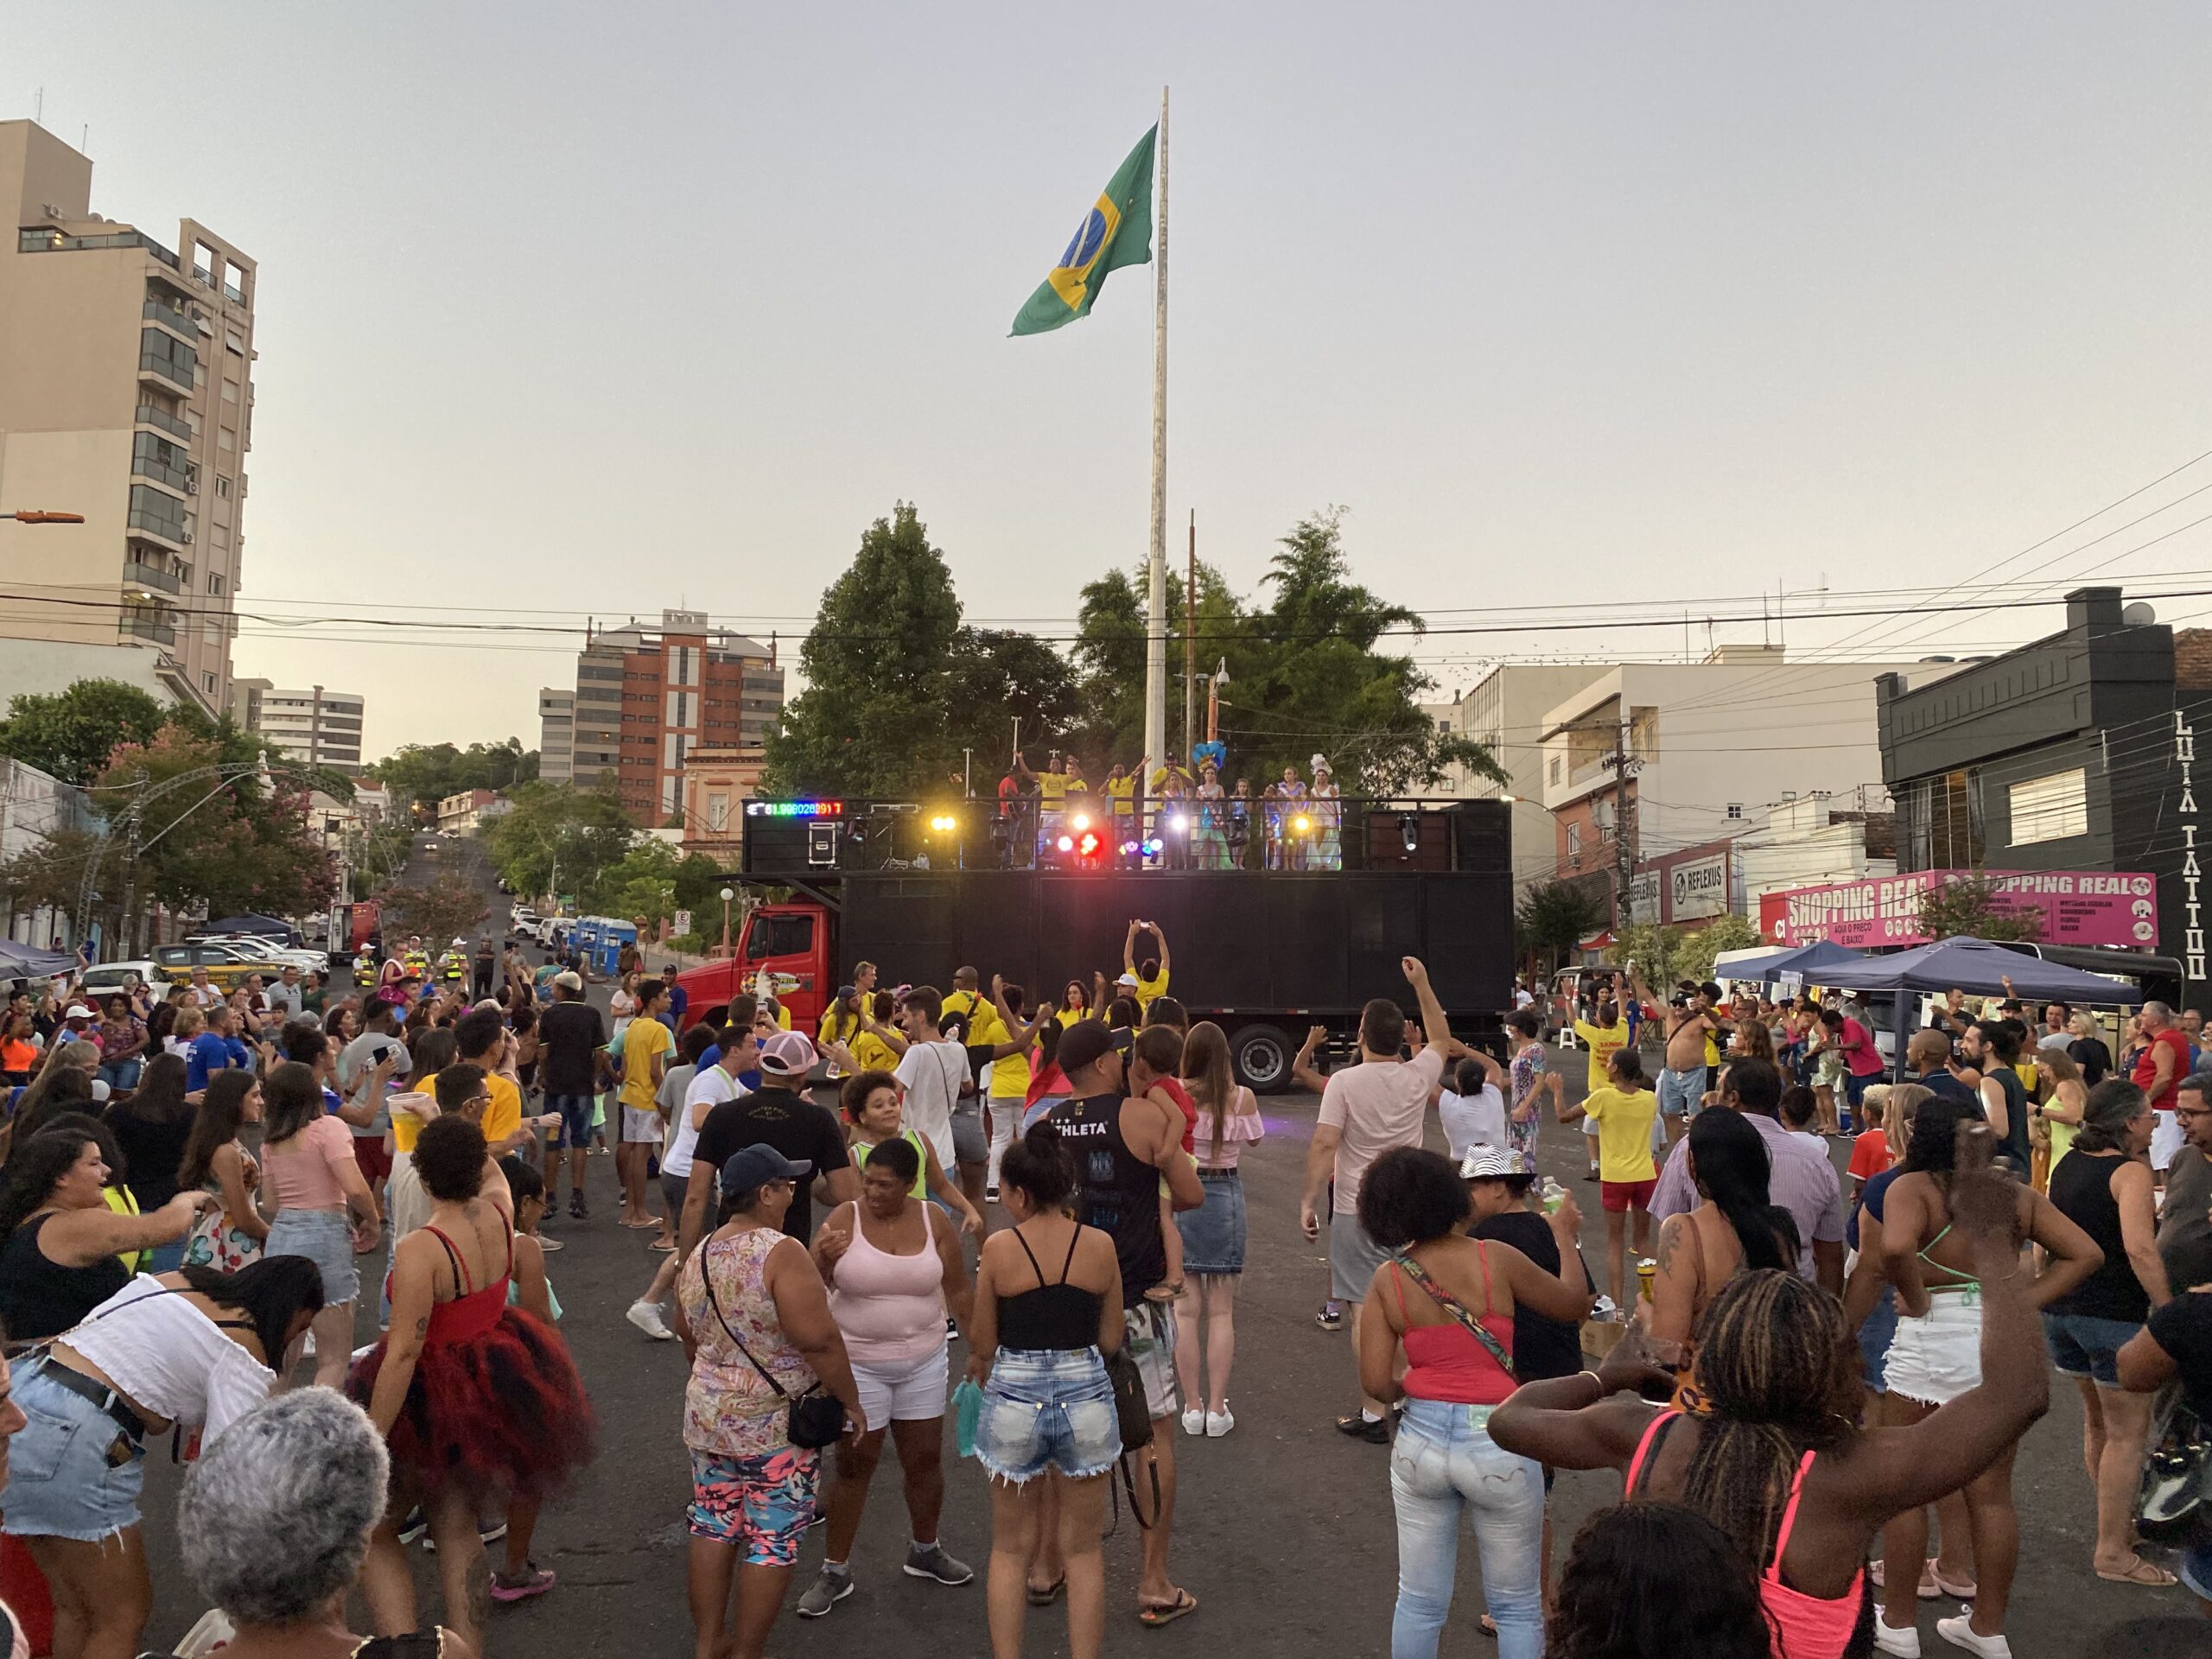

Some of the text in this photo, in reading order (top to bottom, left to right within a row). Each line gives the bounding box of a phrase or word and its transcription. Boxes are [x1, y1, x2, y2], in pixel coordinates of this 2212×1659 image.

[1688, 865, 1722, 891] REFLEXUS
[1964, 874, 2131, 895] OPPING REAL
[1789, 884, 1876, 927] SHOPPING
[2182, 825, 2207, 980] TATTOO
[1055, 1122, 1106, 1136] THLETA
